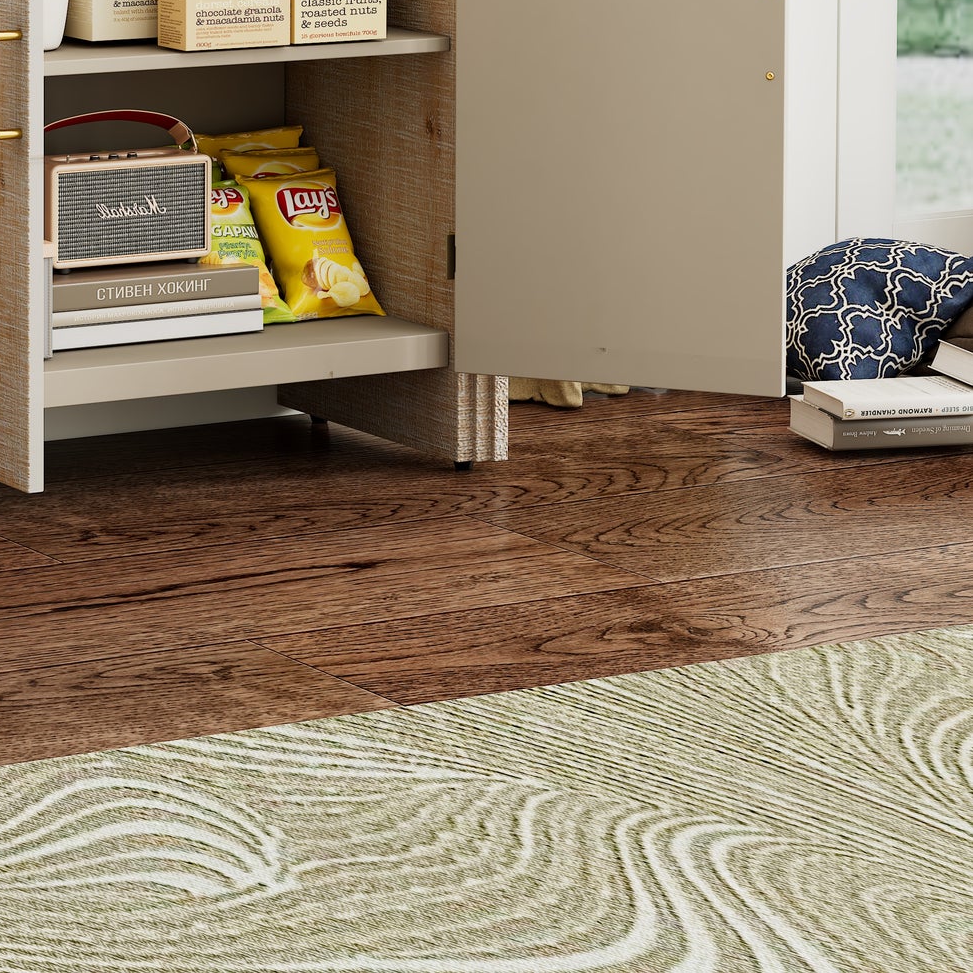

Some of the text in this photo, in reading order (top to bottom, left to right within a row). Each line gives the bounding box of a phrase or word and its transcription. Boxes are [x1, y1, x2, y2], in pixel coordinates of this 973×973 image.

[196, 6, 282, 18] chocolate granola
[301, 6, 377, 18] roasted nuts
[196, 14, 285, 26] & macadamia nuts
[301, 18, 348, 28] & seeds
[283, 187, 337, 219] Lay's
[97, 278, 211, 301] СТИВЕН ХОКИНГ
[860, 409, 896, 417] CHANDLER
[898, 407, 933, 415] RAYMOND
[912, 426, 935, 434] Sweden
